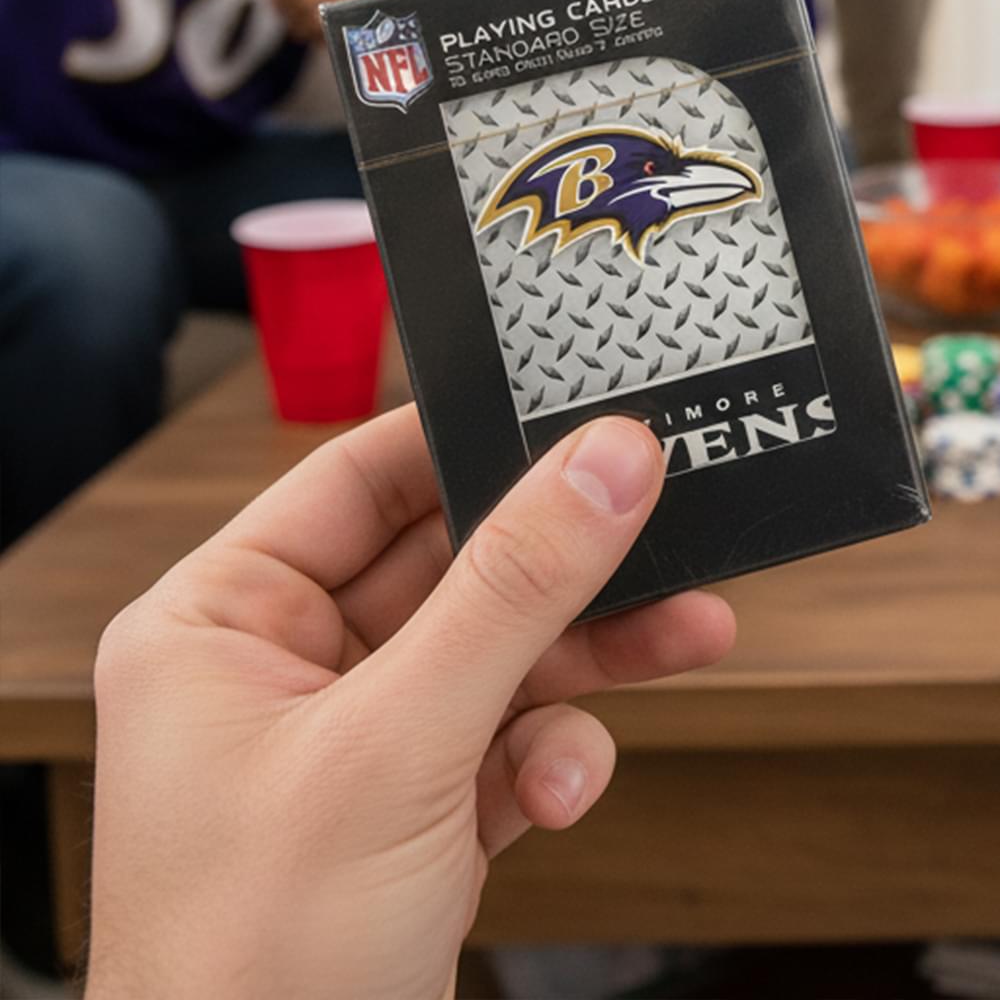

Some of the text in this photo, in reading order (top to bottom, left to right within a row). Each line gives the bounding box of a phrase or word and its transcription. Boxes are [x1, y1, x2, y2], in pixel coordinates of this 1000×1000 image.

[439, 9, 556, 53] PLAYING
[589, 10, 645, 37] SIZE
[361, 44, 430, 94] NFL
[644, 382, 786, 427] IMORE
